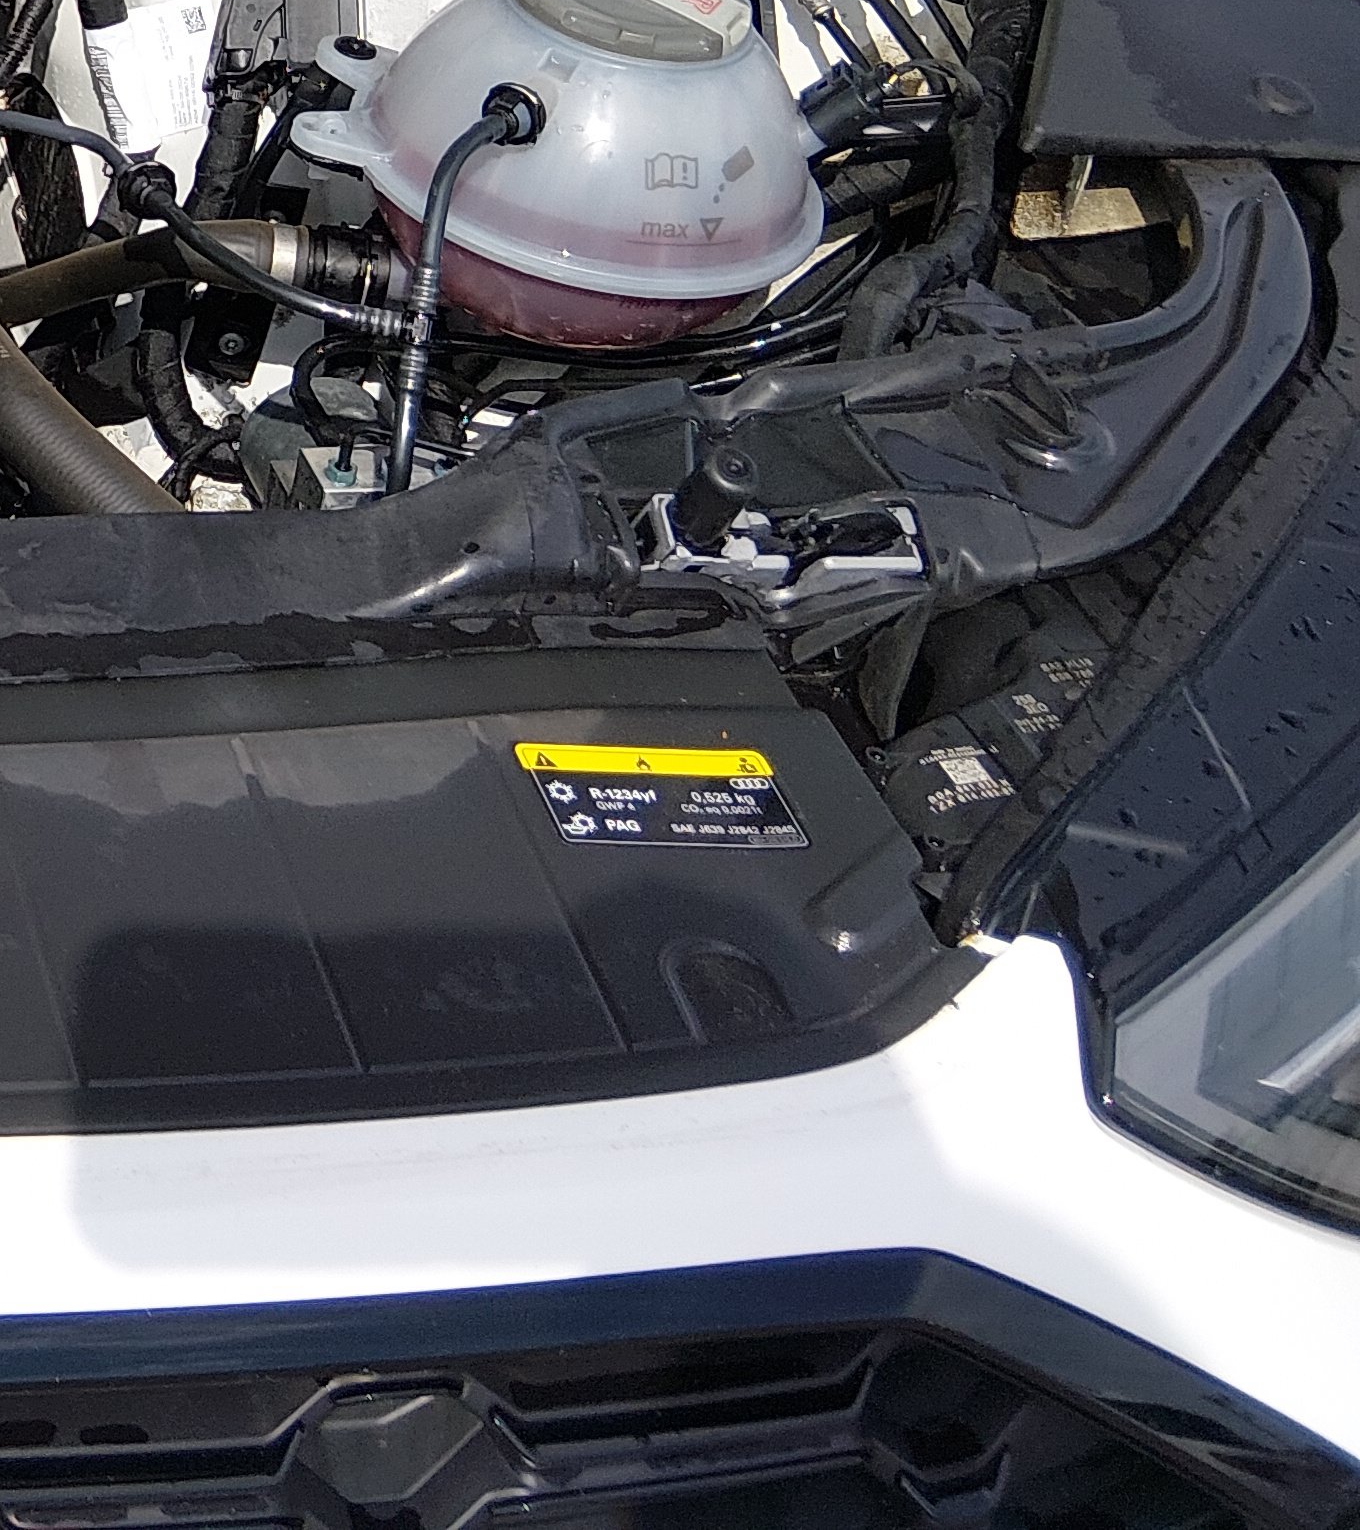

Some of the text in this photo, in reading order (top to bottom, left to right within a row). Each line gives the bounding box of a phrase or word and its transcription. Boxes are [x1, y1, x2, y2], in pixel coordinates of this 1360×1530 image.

[640, 221, 688, 239] max
[588, 787, 757, 807] R-1234yf 0,525 kg
[604, 818, 642, 833] PAG
[670, 823, 697, 835] SAE
